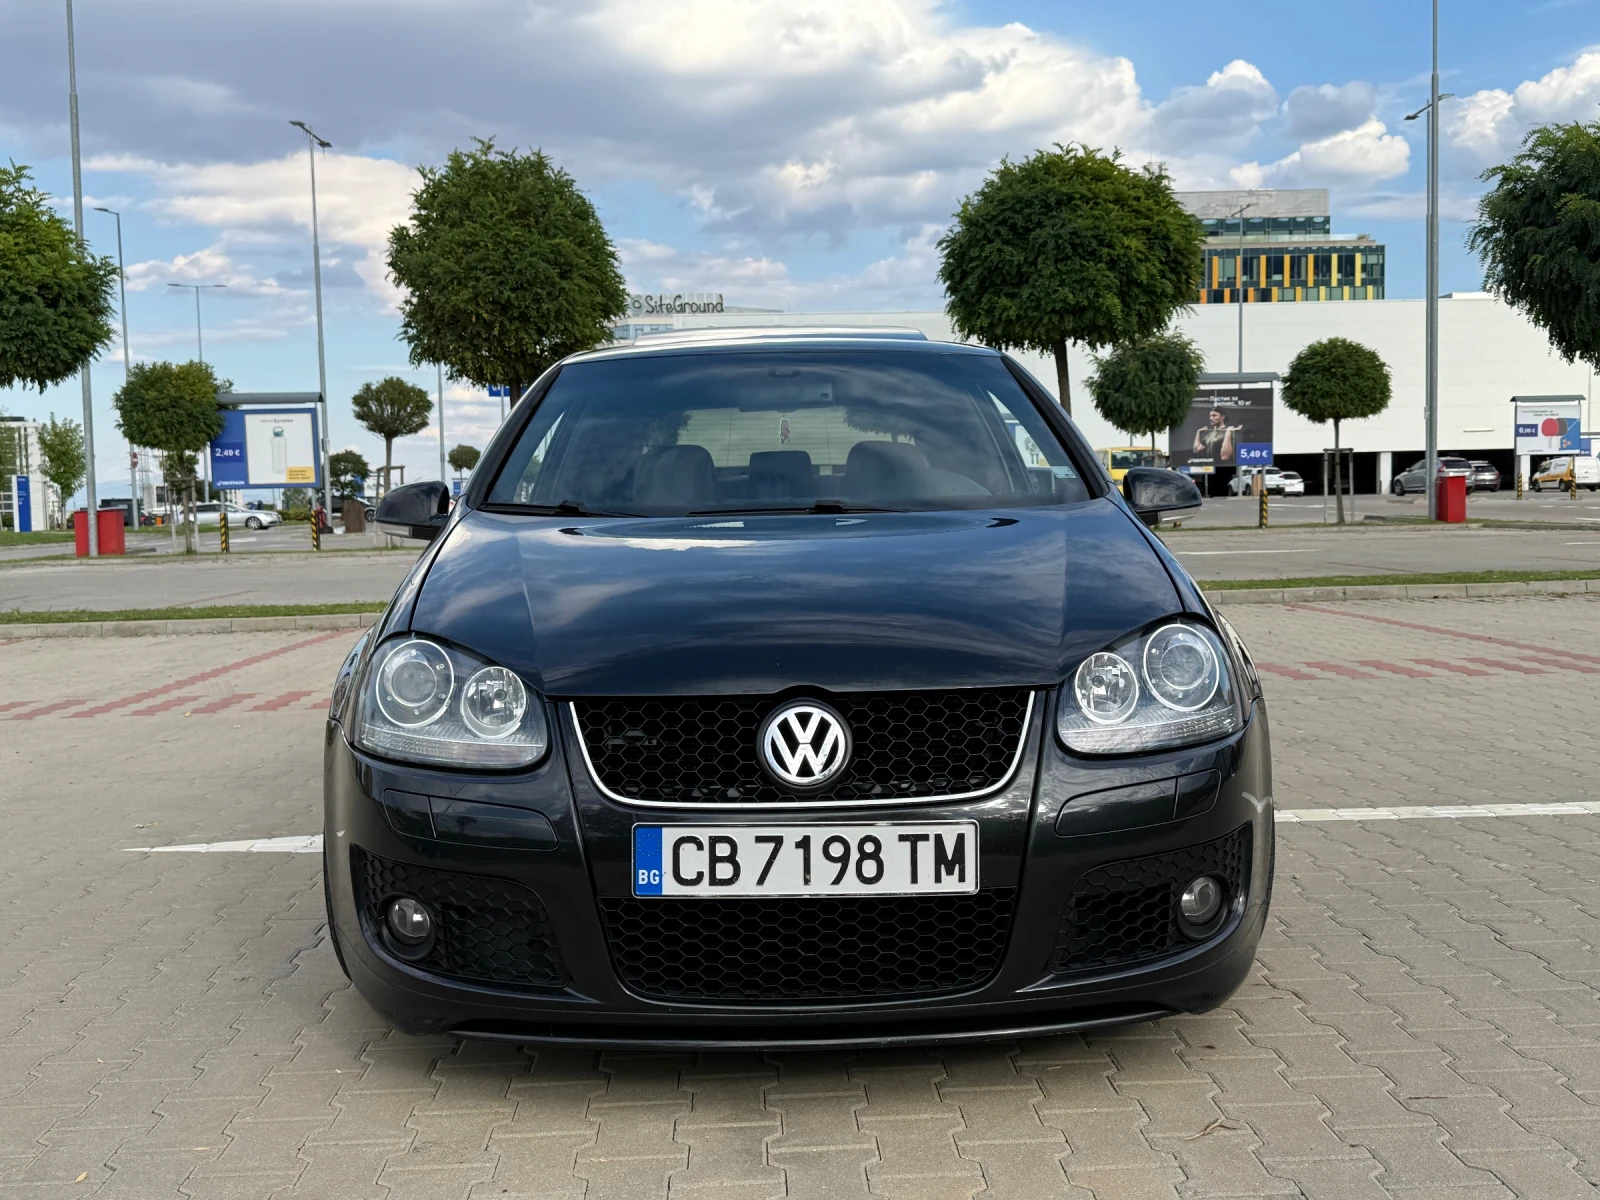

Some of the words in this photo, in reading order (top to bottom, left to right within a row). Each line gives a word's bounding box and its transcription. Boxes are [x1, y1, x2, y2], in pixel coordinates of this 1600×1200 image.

[645, 294, 725, 314] SiteGround
[1240, 448, 1260, 459] 5,49
[672, 835, 742, 887] CB
[754, 834, 884, 886] 7198
[898, 832, 966, 885] TM
[638, 869, 660, 885] BG
